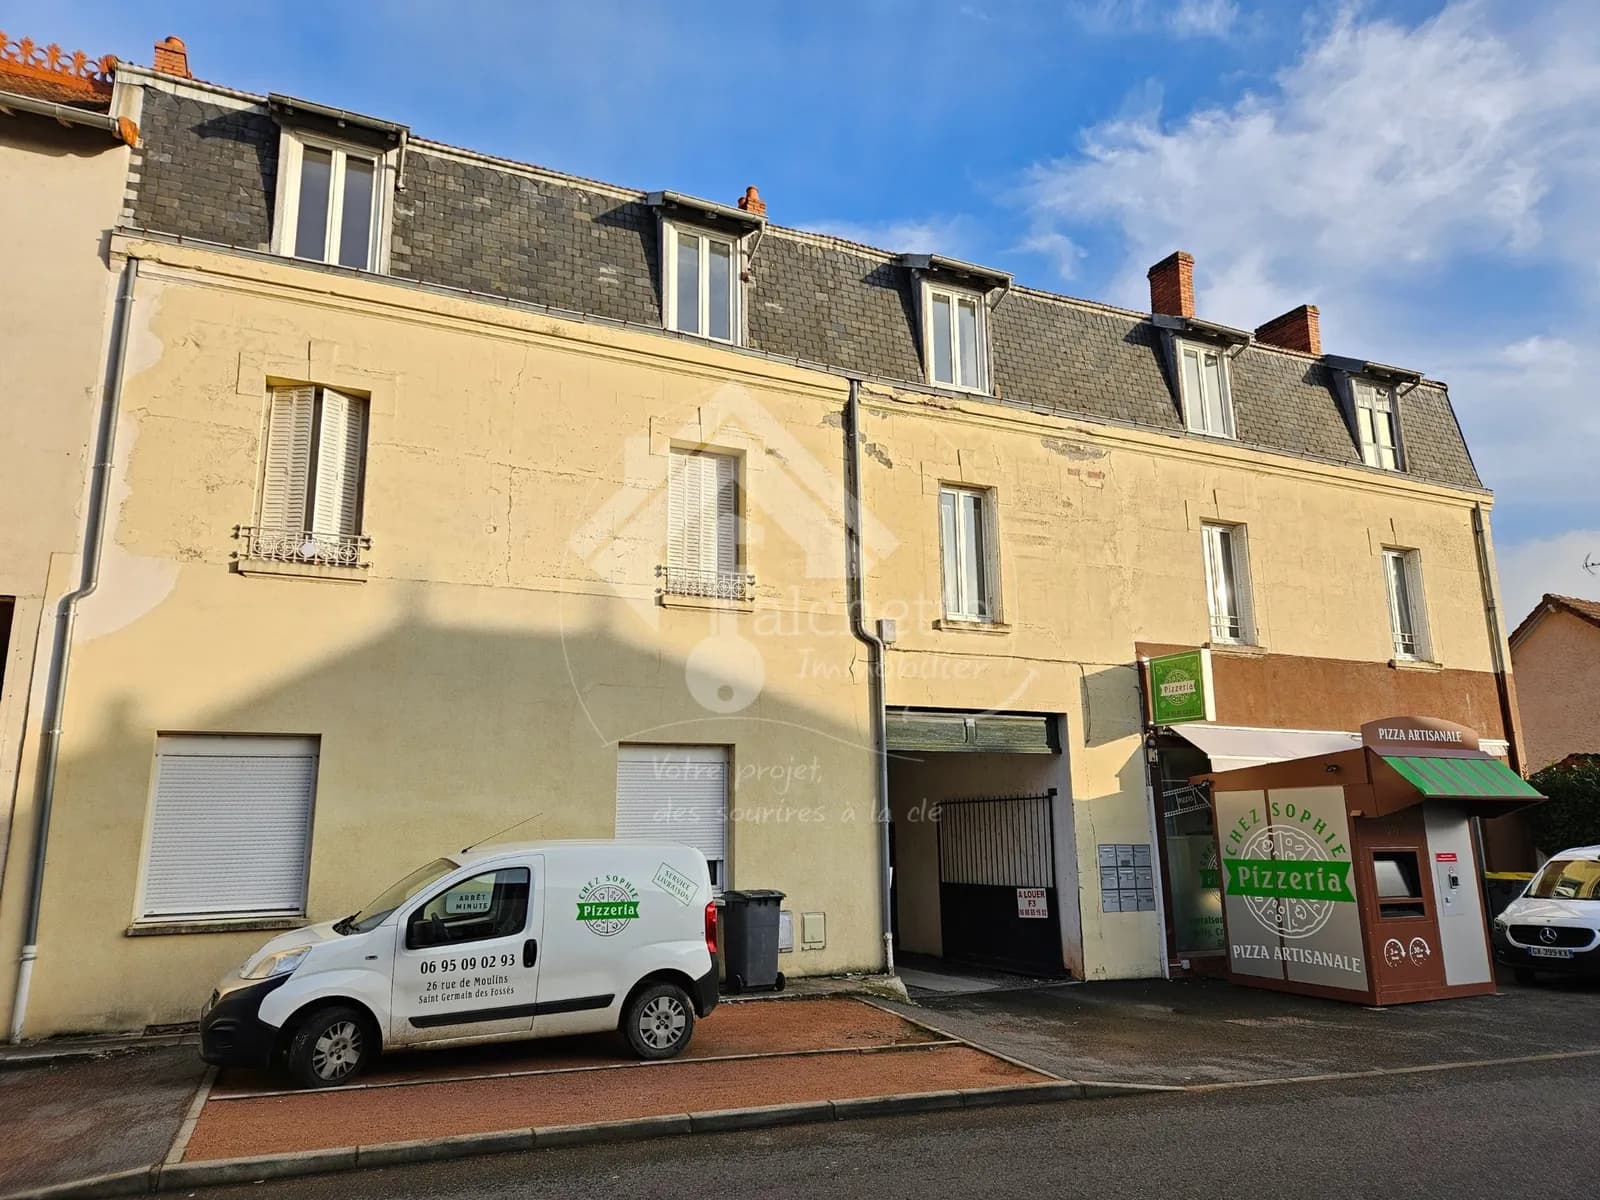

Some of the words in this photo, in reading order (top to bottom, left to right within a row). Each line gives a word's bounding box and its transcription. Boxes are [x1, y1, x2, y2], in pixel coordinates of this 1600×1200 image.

[1164, 684, 1194, 693] Pizzeria
[1378, 728, 1406, 741] PIZZA
[1408, 729, 1463, 743] ARTISANALE
[1225, 808, 1261, 857] CHEZ
[1272, 802, 1347, 858] SOPHIE
[578, 876, 600, 900] CHEZ
[606, 874, 640, 900] SOPHIE
[656, 874, 690, 901] LIVRAISON
[664, 869, 691, 891] SERVICE
[1238, 865, 1343, 893] Pizzeria
[459, 893, 487, 902] ARRÊT
[1023, 890, 1046, 899] LOUER
[455, 902, 489, 910] MINUTE
[583, 904, 636, 917] Pizzeria
[420, 961, 437, 975] 06
[441, 959, 457, 973] 95
[461, 957, 477, 971] 09
[480, 955, 496, 969] 02
[500, 953, 516, 967] 93
[1233, 944, 1271, 960] PIZZA
[1274, 946, 1362, 974] ARTISANALE
[426, 981, 438, 992] 26
[441, 979, 456, 990] rue
[459, 978, 471, 988] de
[473, 975, 508, 987] Moulins
[418, 994, 439, 1004] Saint
[441, 991, 473, 1002] Germain
[475, 989, 488, 998] des
